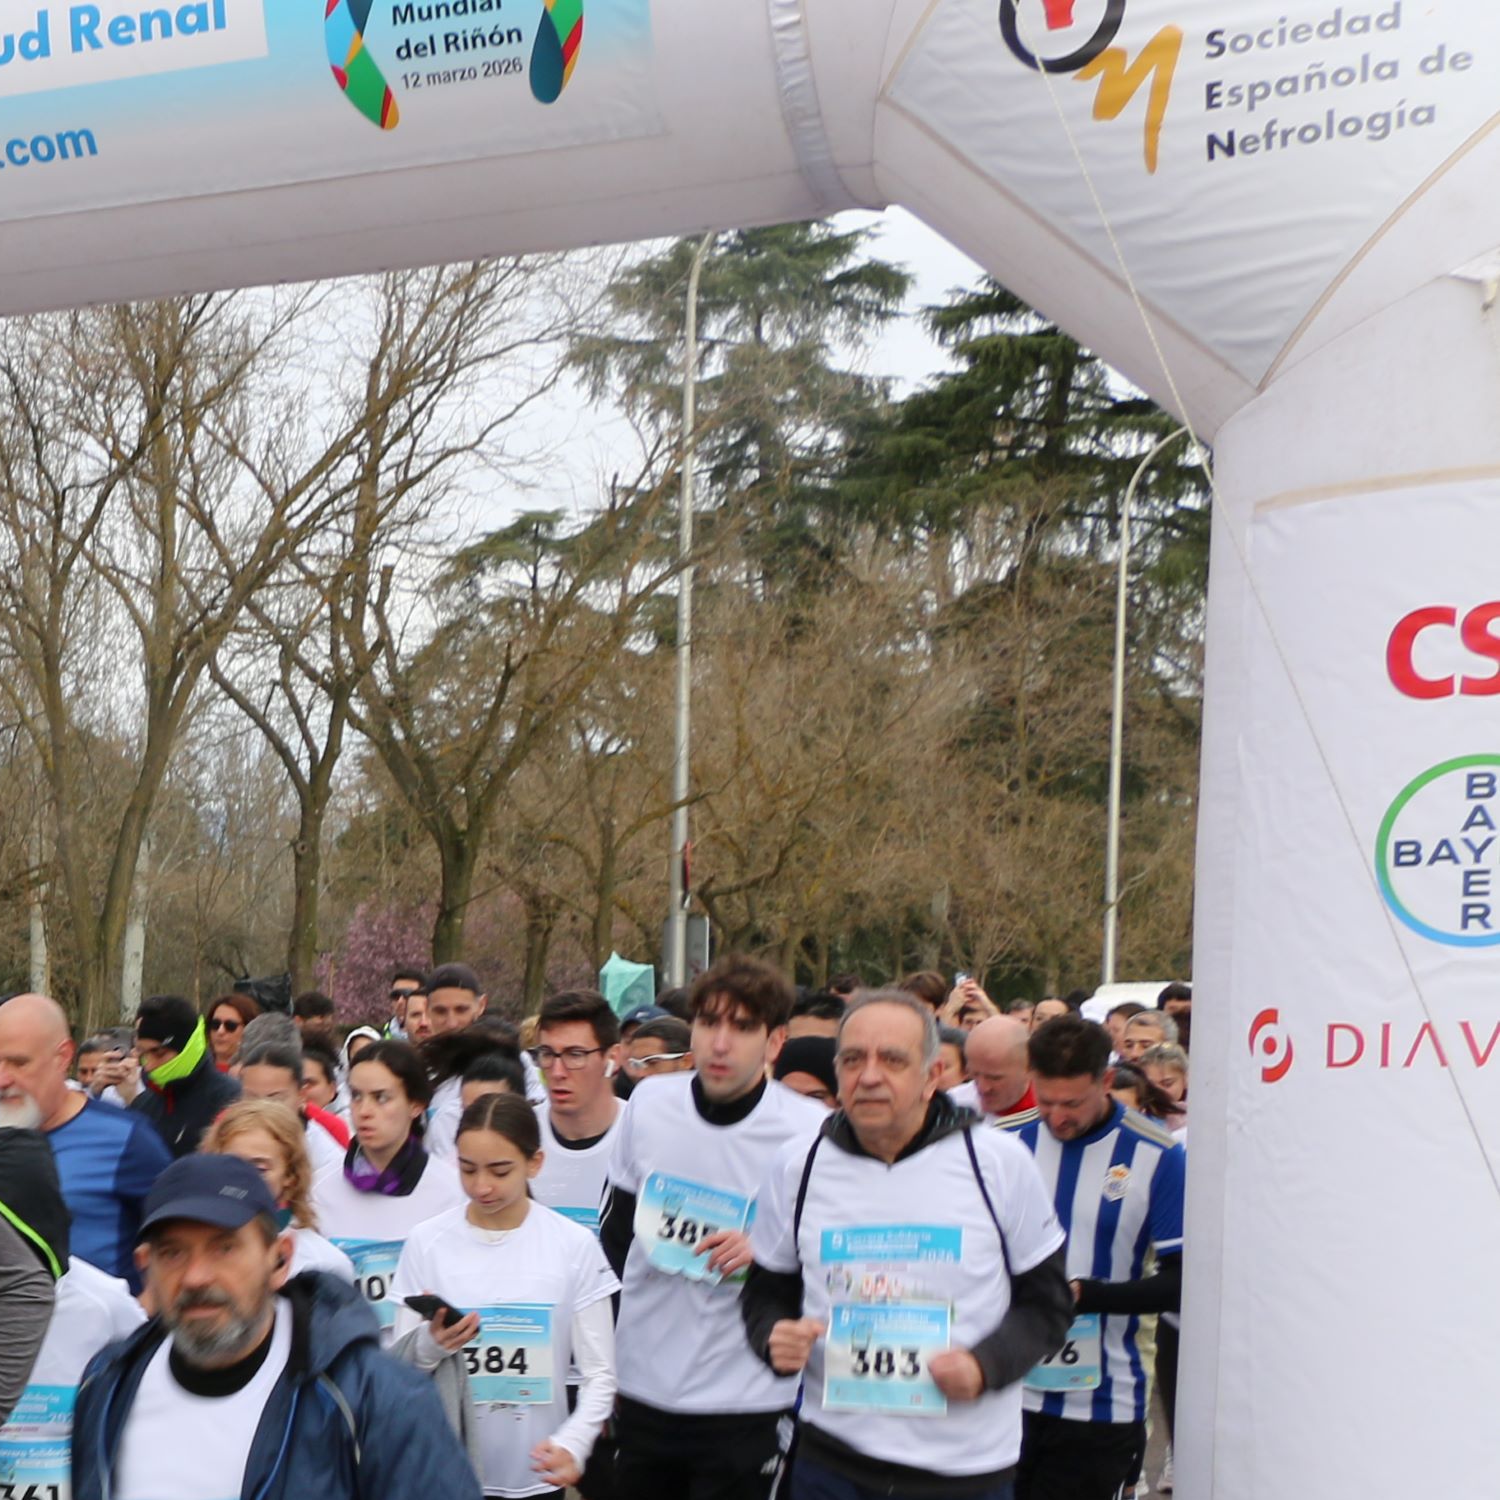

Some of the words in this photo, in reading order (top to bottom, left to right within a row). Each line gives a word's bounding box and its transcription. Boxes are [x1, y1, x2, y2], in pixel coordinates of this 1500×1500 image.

[69, 0, 228, 54] Renal
[395, 32, 438, 62] del
[444, 25, 524, 55] Riñón
[1204, 0, 1403, 60] Sociedad
[400, 70, 422, 90] 12
[425, 65, 478, 87] marzo
[481, 56, 524, 79] 2026
[1204, 52, 1401, 113] Española
[1417, 42, 1474, 76] de
[1206, 97, 1437, 163] Nefrología
[1392, 835, 1500, 868] BAY
[1459, 771, 1497, 931] BAYER
[464, 1345, 529, 1375] 384
[851, 1346, 921, 1377] 383
